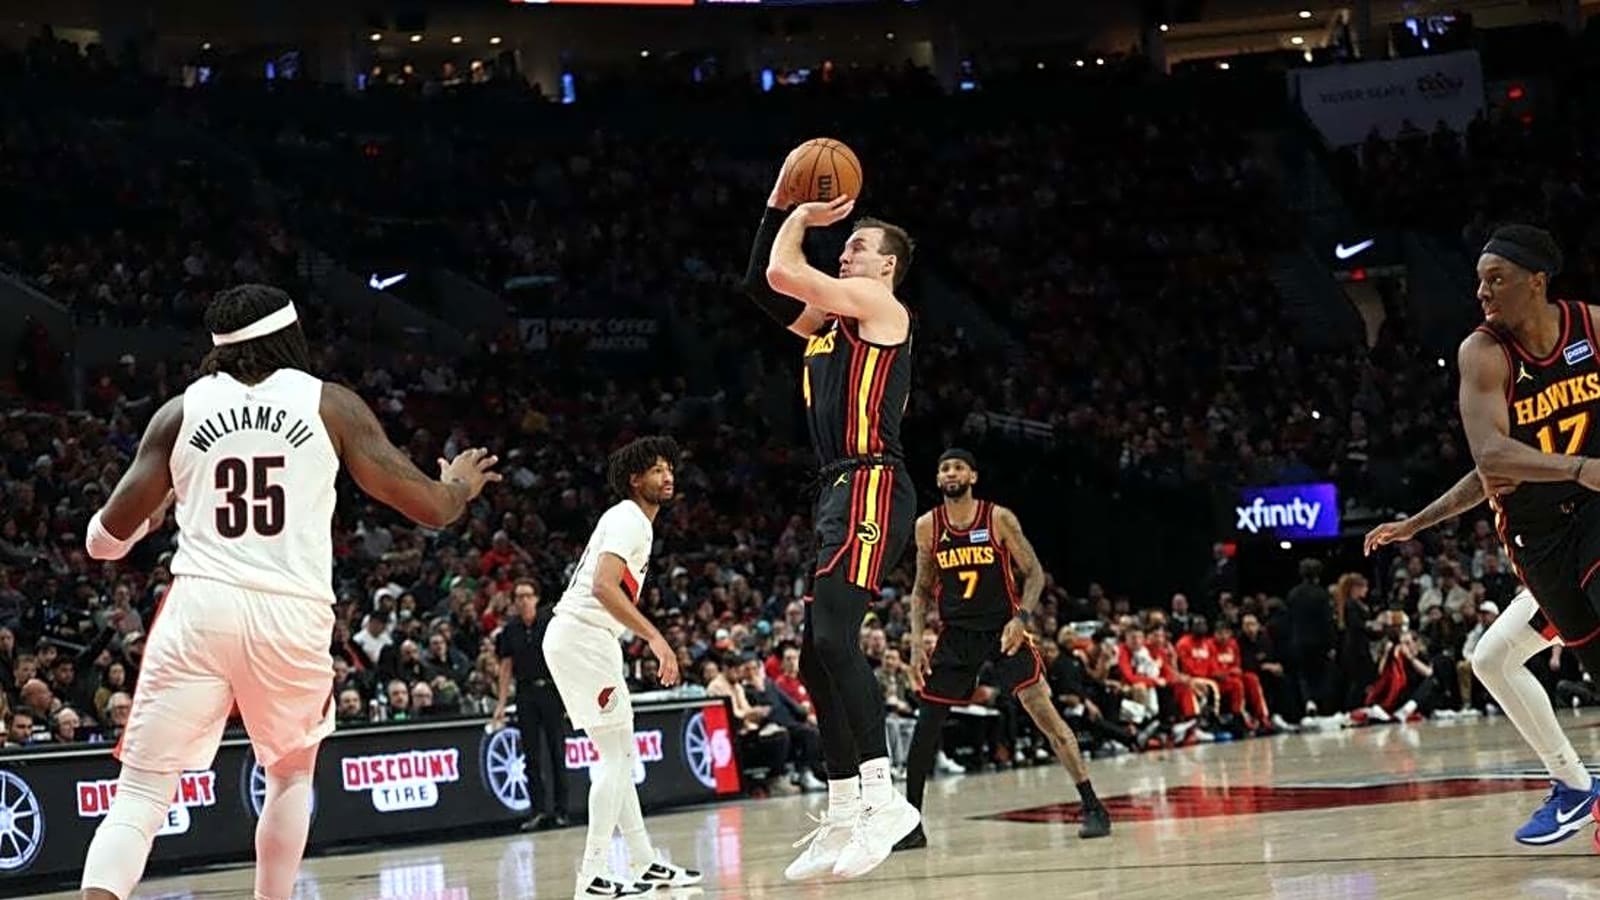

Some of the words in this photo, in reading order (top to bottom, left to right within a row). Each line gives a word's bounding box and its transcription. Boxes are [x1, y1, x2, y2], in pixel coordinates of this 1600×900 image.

[1514, 372, 1600, 425] HAWKS
[189, 406, 287, 453] WILLIAMS
[285, 419, 314, 448] III
[1536, 411, 1589, 456] 17
[213, 454, 287, 541] 35
[1236, 497, 1321, 533] xfinity
[936, 546, 994, 570] HAWKS
[958, 571, 978, 599] 7
[564, 732, 661, 767] DISNT
[344, 751, 457, 788] DISCOUNT
[382, 785, 429, 804] TIRE
